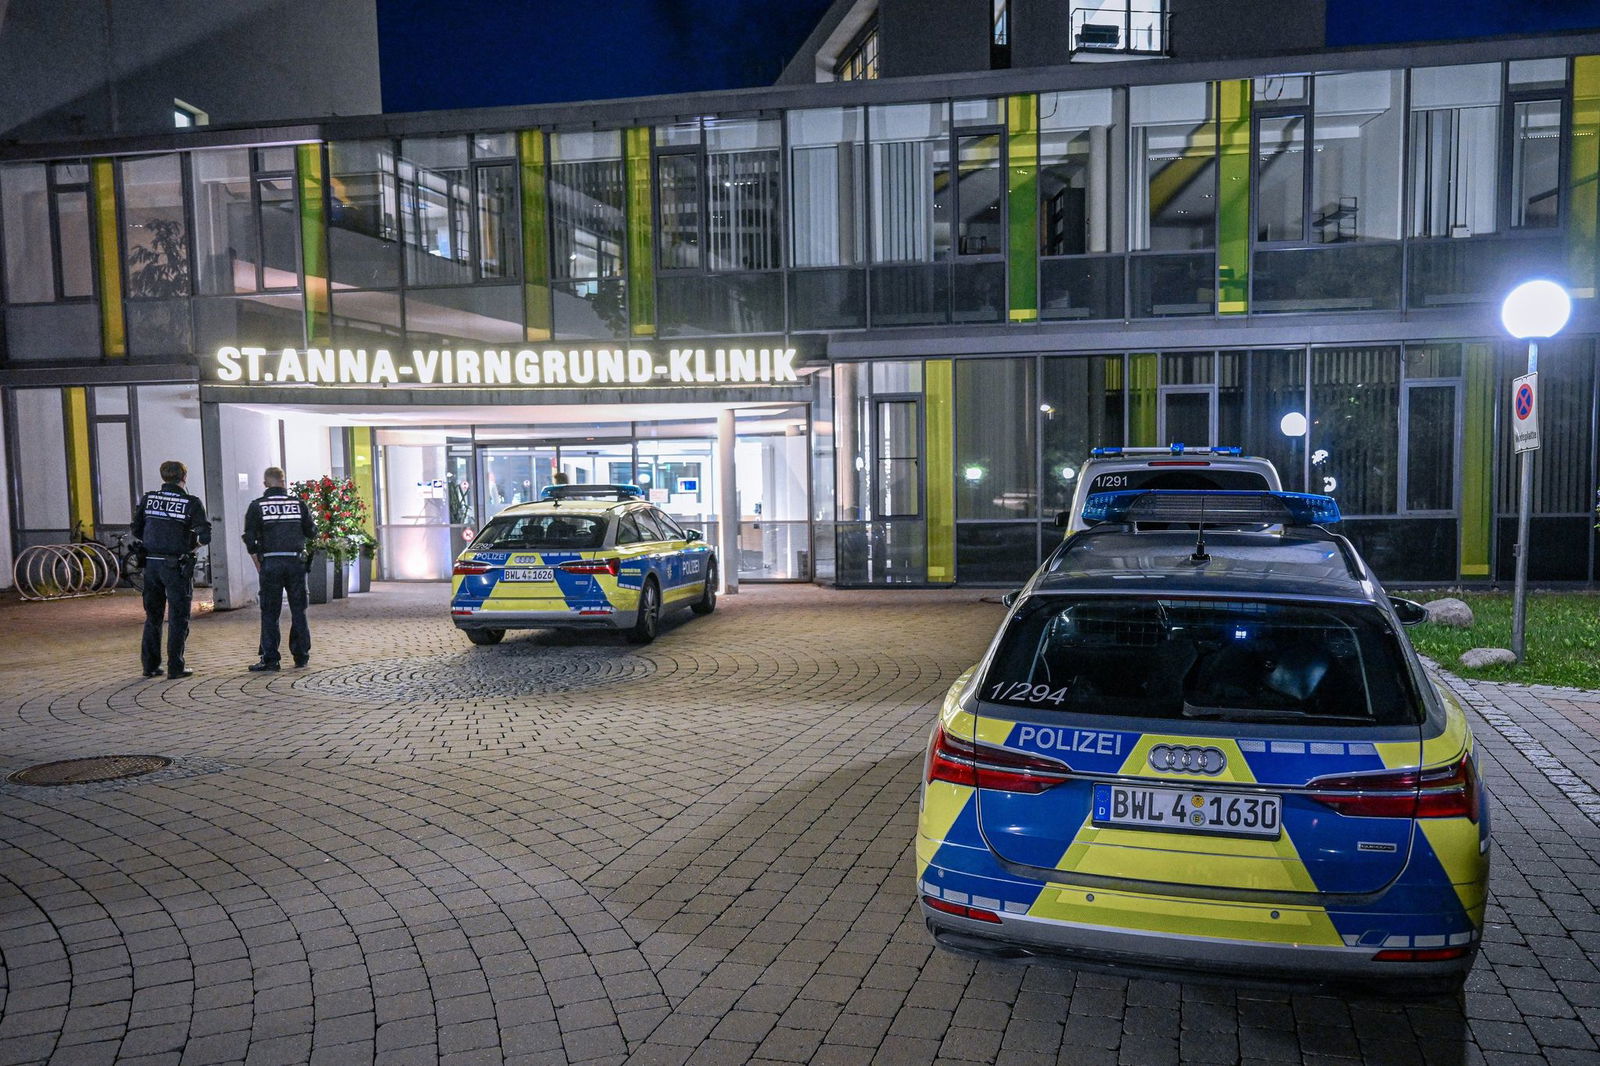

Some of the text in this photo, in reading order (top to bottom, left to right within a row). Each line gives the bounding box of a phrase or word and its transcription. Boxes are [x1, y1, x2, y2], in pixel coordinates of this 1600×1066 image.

[1095, 476, 1128, 487] 1/291
[146, 499, 186, 514] POLIZEI
[262, 505, 301, 515] POLIZEI
[476, 552, 507, 560] POLIZEI
[505, 570, 520, 579] BWL
[533, 570, 552, 579] 1626
[682, 560, 700, 575] POLIZEI
[991, 681, 1068, 705] 1/294
[1018, 727, 1122, 755] POLIZEI
[1113, 789, 1277, 829] BWL 4 1630
